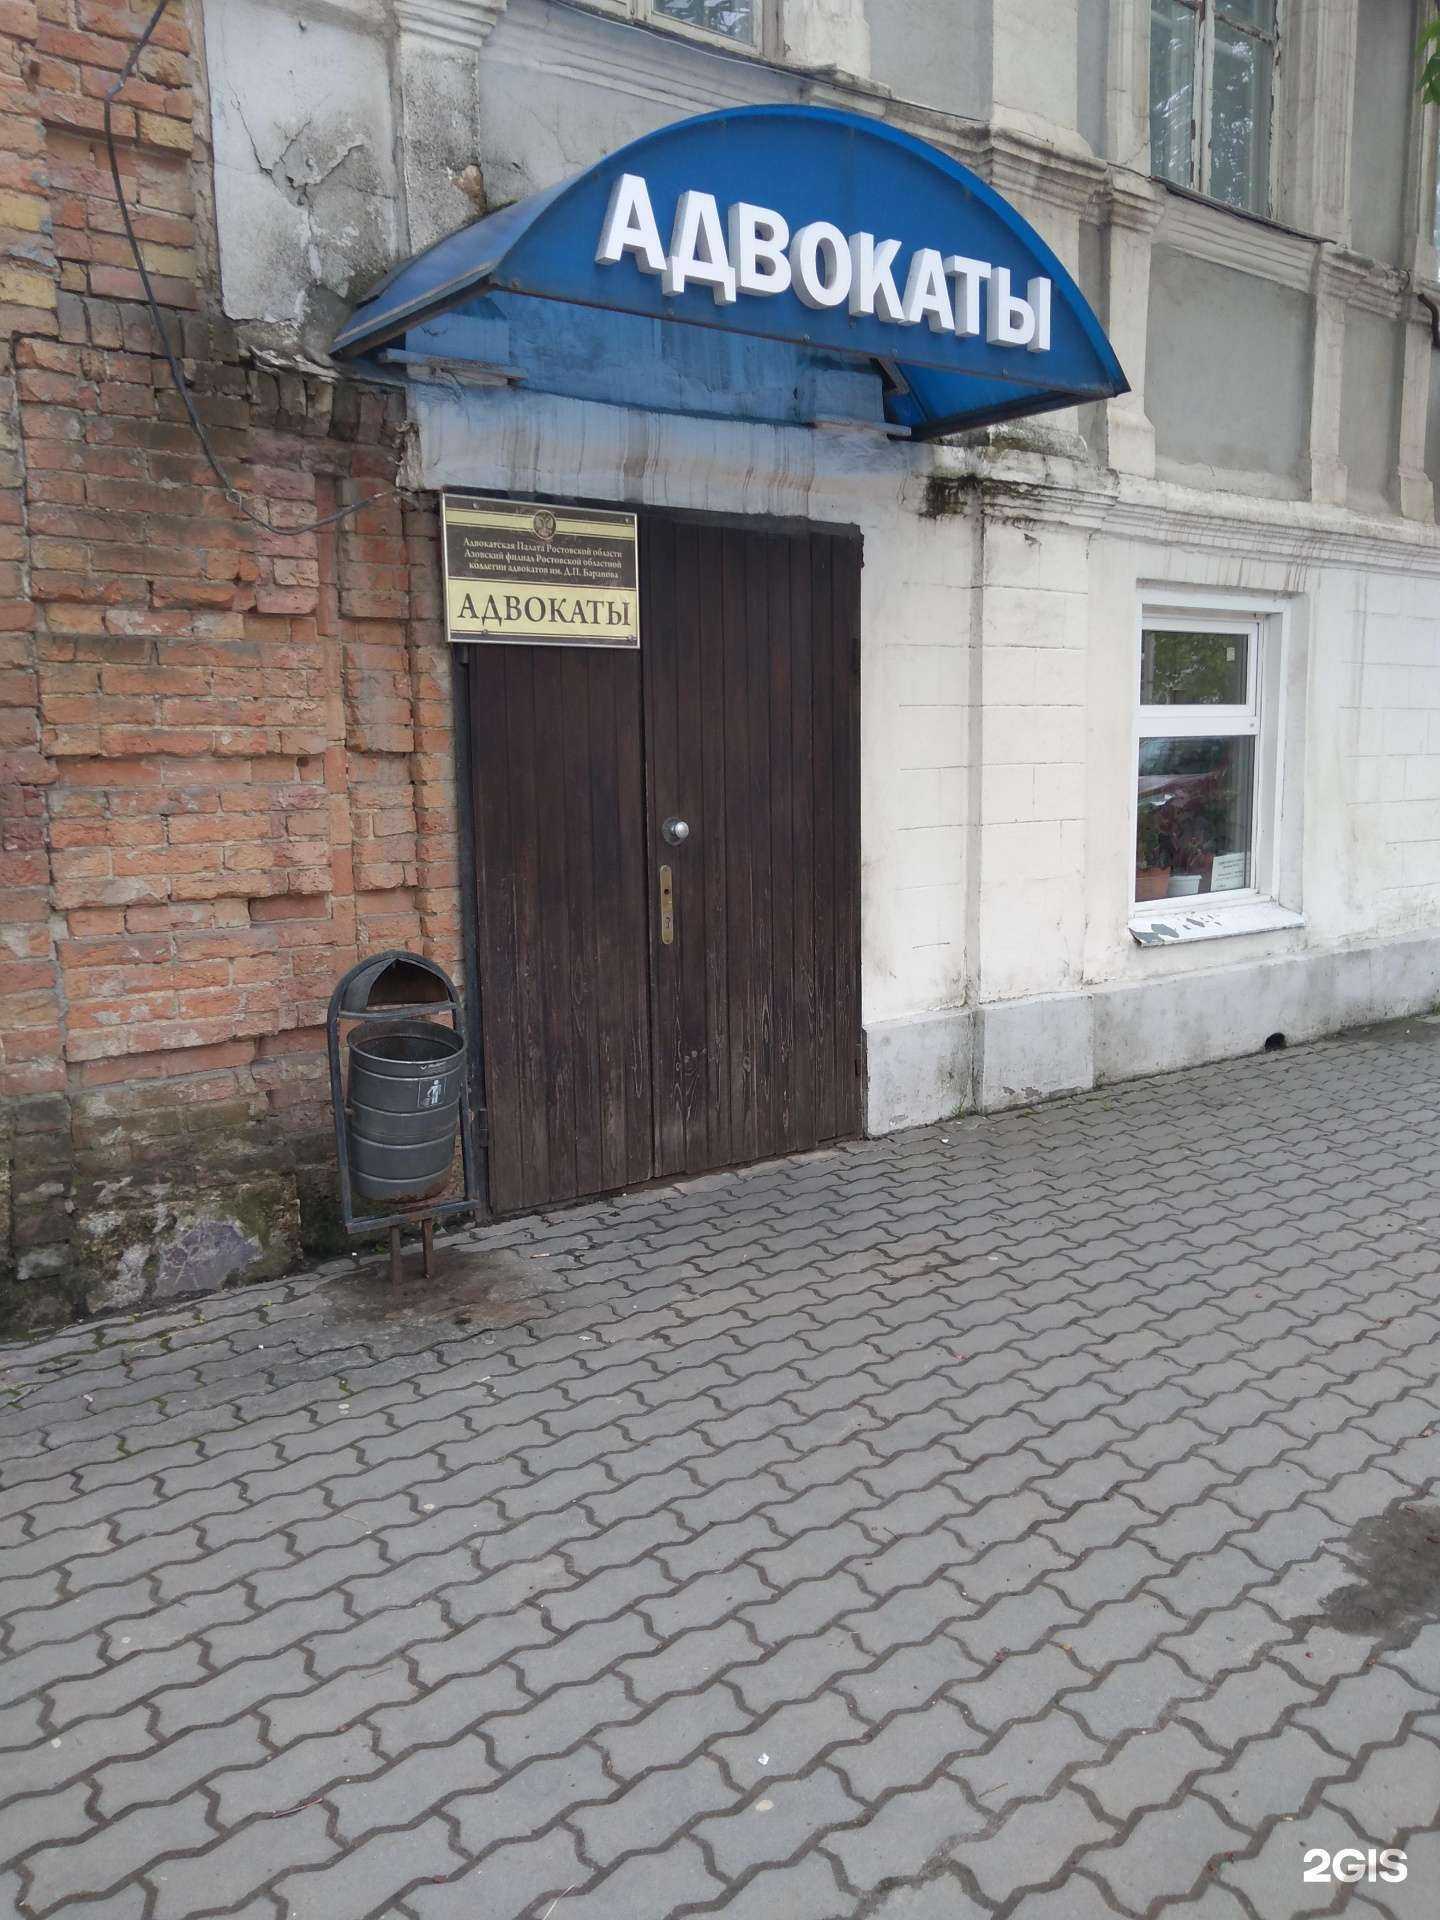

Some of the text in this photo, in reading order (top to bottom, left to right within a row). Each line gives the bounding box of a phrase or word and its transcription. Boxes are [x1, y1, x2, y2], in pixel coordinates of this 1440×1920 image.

[595, 173, 1052, 353] АДВОКАТЫ
[463, 537, 623, 558] Адвокатская Палата Ростовской области
[464, 549, 622, 569] Азовский филиал Ростовской областной
[469, 561, 507, 571] коллегии
[508, 564, 548, 574] адвокатов
[583, 568, 619, 579] Баранова
[457, 592, 632, 628] АДВОКАТЫ
